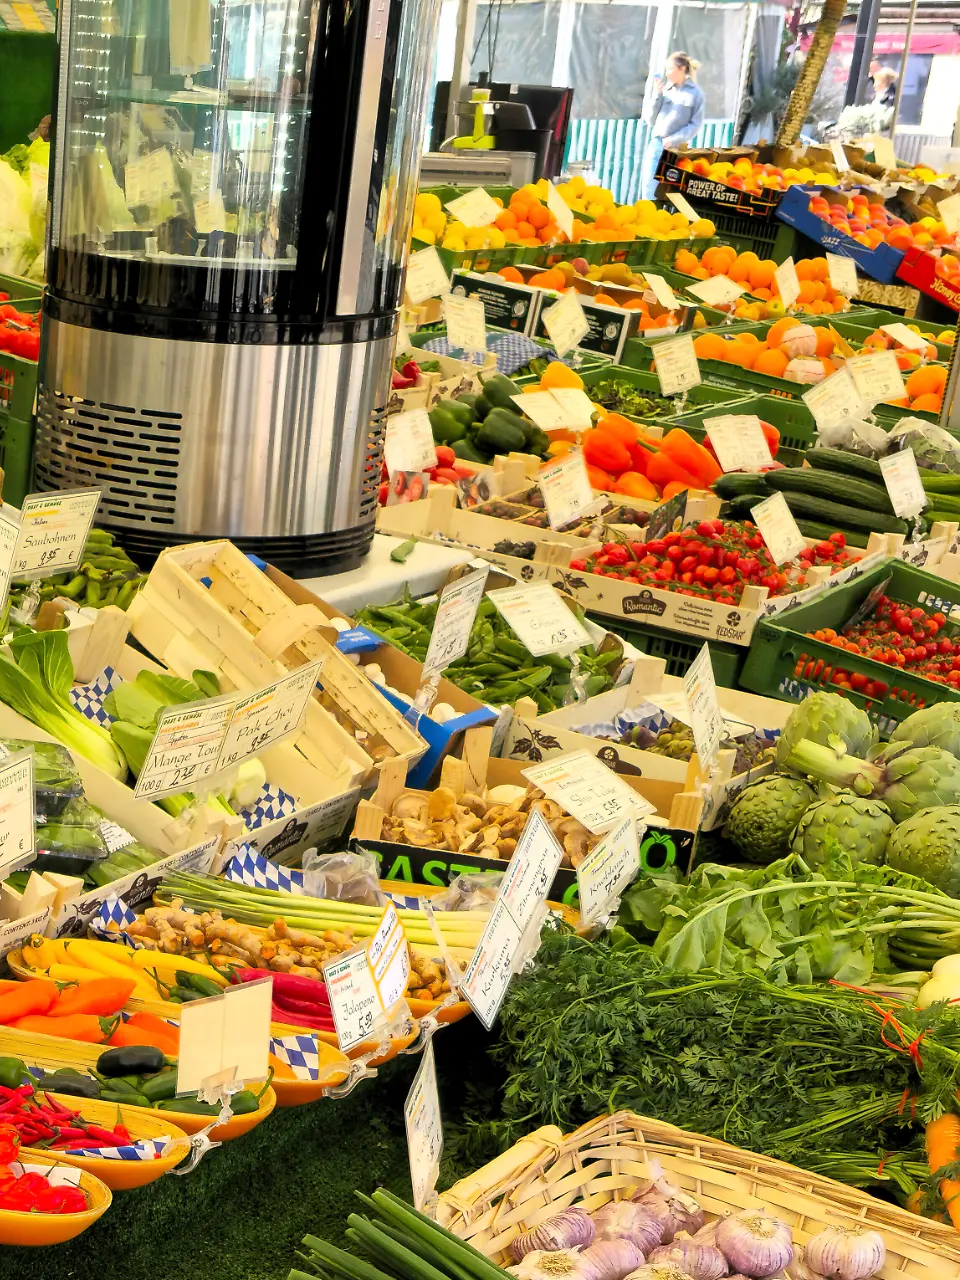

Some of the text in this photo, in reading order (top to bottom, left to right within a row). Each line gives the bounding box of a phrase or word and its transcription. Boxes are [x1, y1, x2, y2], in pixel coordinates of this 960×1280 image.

[688, 180, 714, 191] POWER
[687, 188, 738, 202] GREAT TASTE!
[23, 533, 77, 549] Saubohnen
[19, 551, 74, 571] kg €
[624, 600, 664, 614] Romantic
[716, 625, 746, 640] REDSTAR
[237, 703, 294, 742] Pak Choi
[227, 722, 290, 764] kg €
[148, 752, 191, 772] Mange
[204, 764, 210, 774] €
[19, 839, 24, 849] €
[589, 849, 631, 897] Knoblauch
[342, 995, 375, 1021] Jalapeno
